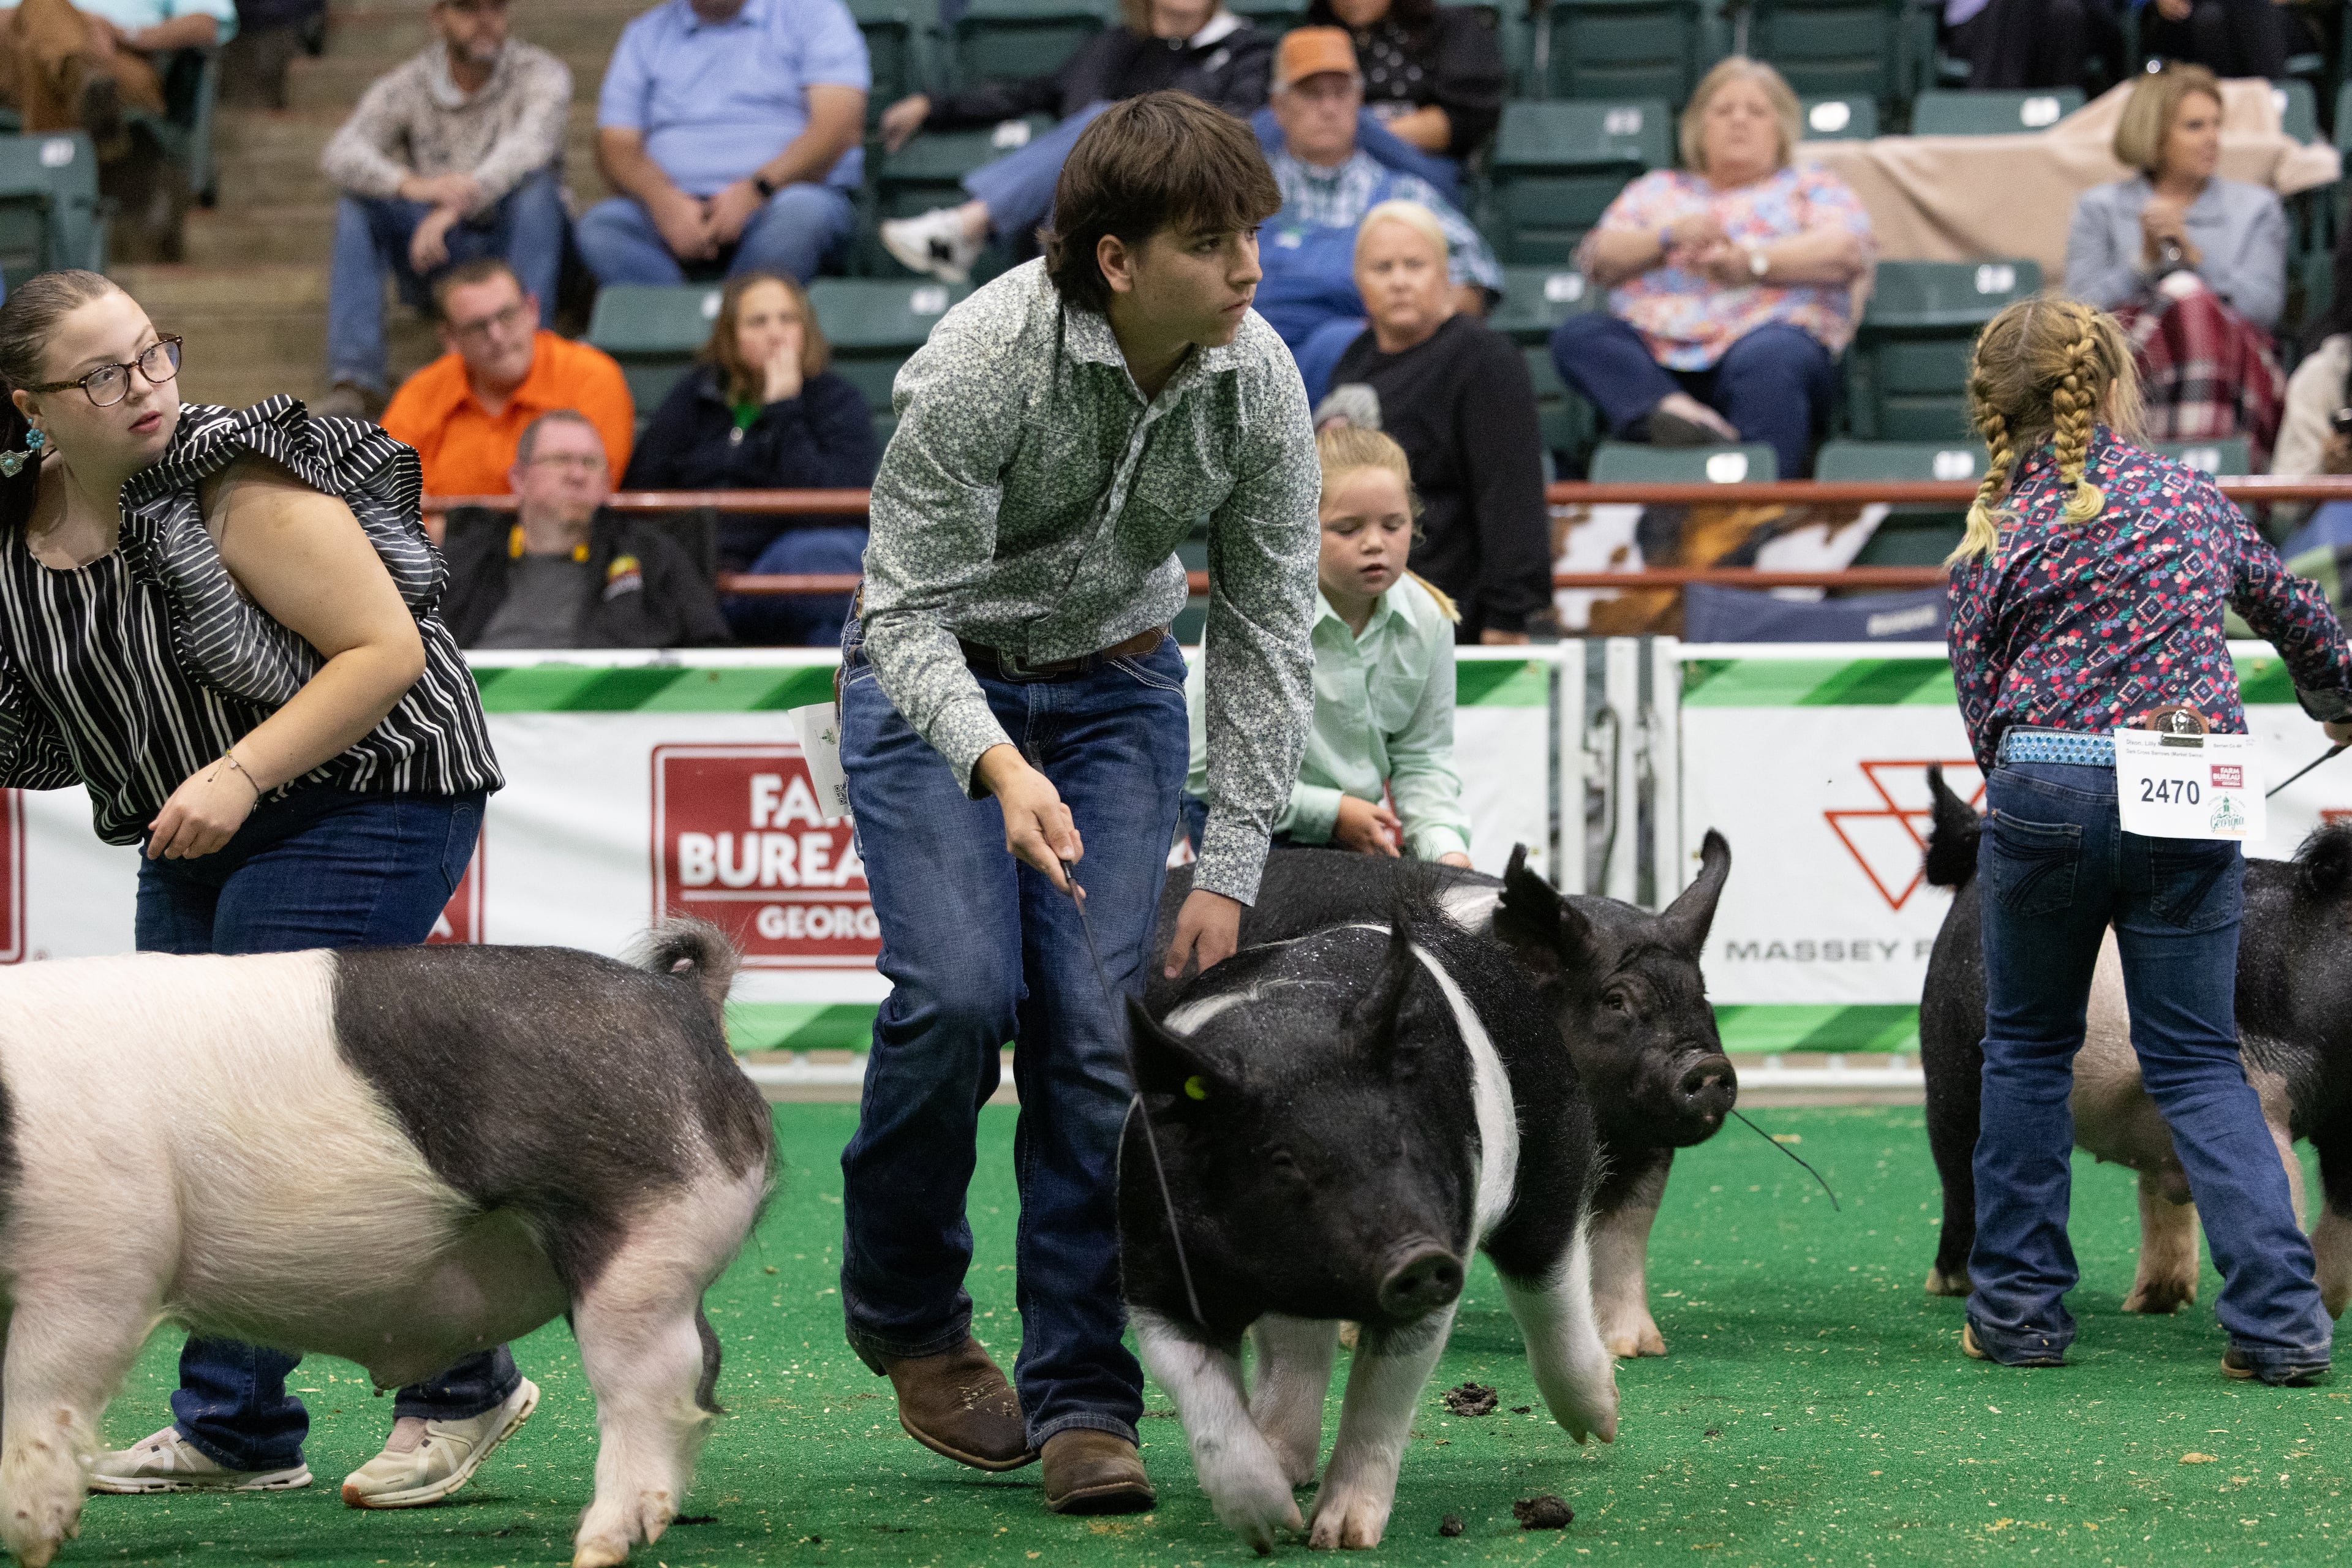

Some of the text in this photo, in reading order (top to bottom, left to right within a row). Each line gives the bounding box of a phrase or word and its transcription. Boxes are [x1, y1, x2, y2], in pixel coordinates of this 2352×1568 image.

[750, 774, 854, 828] FA
[2140, 778, 2200, 805] 2470
[677, 832, 870, 888] BUREA
[757, 905, 881, 939] GEORG
[1725, 940, 1900, 961] MASSEY
